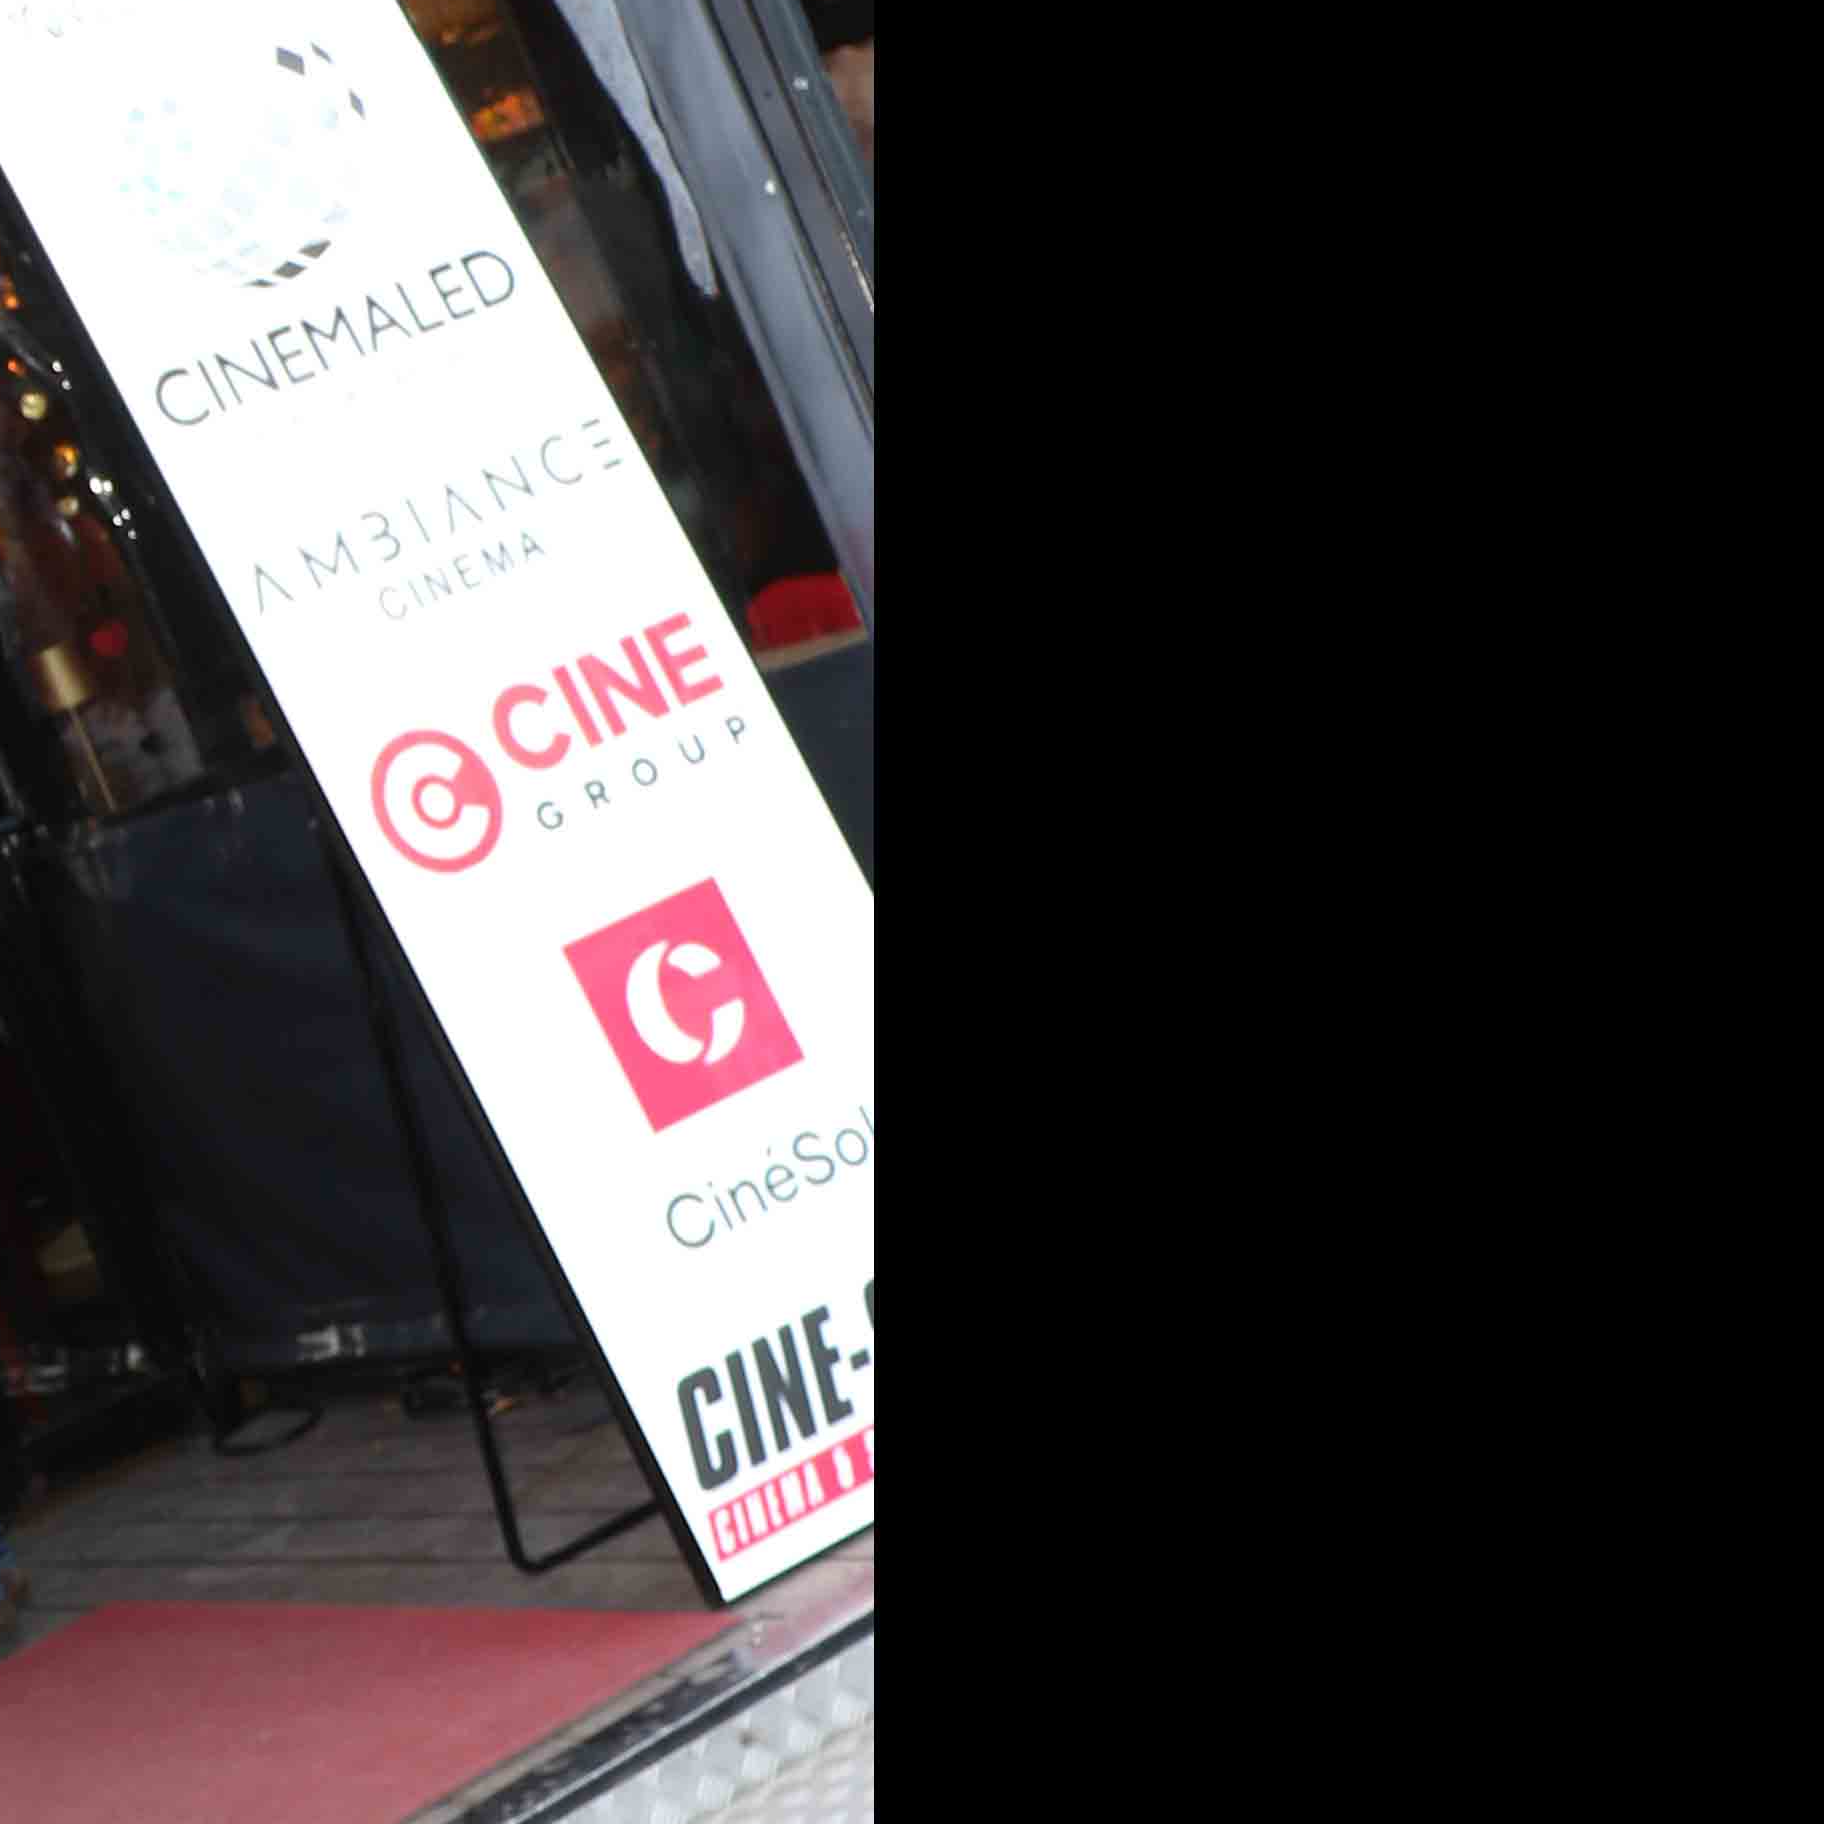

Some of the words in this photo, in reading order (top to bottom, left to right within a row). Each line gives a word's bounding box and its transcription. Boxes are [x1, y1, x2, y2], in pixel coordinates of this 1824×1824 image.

[155, 249, 515, 426] CINEMALED
[378, 531, 545, 620] CINEMA
[492, 613, 724, 771] CINE
[536, 714, 746, 831] GROUP
